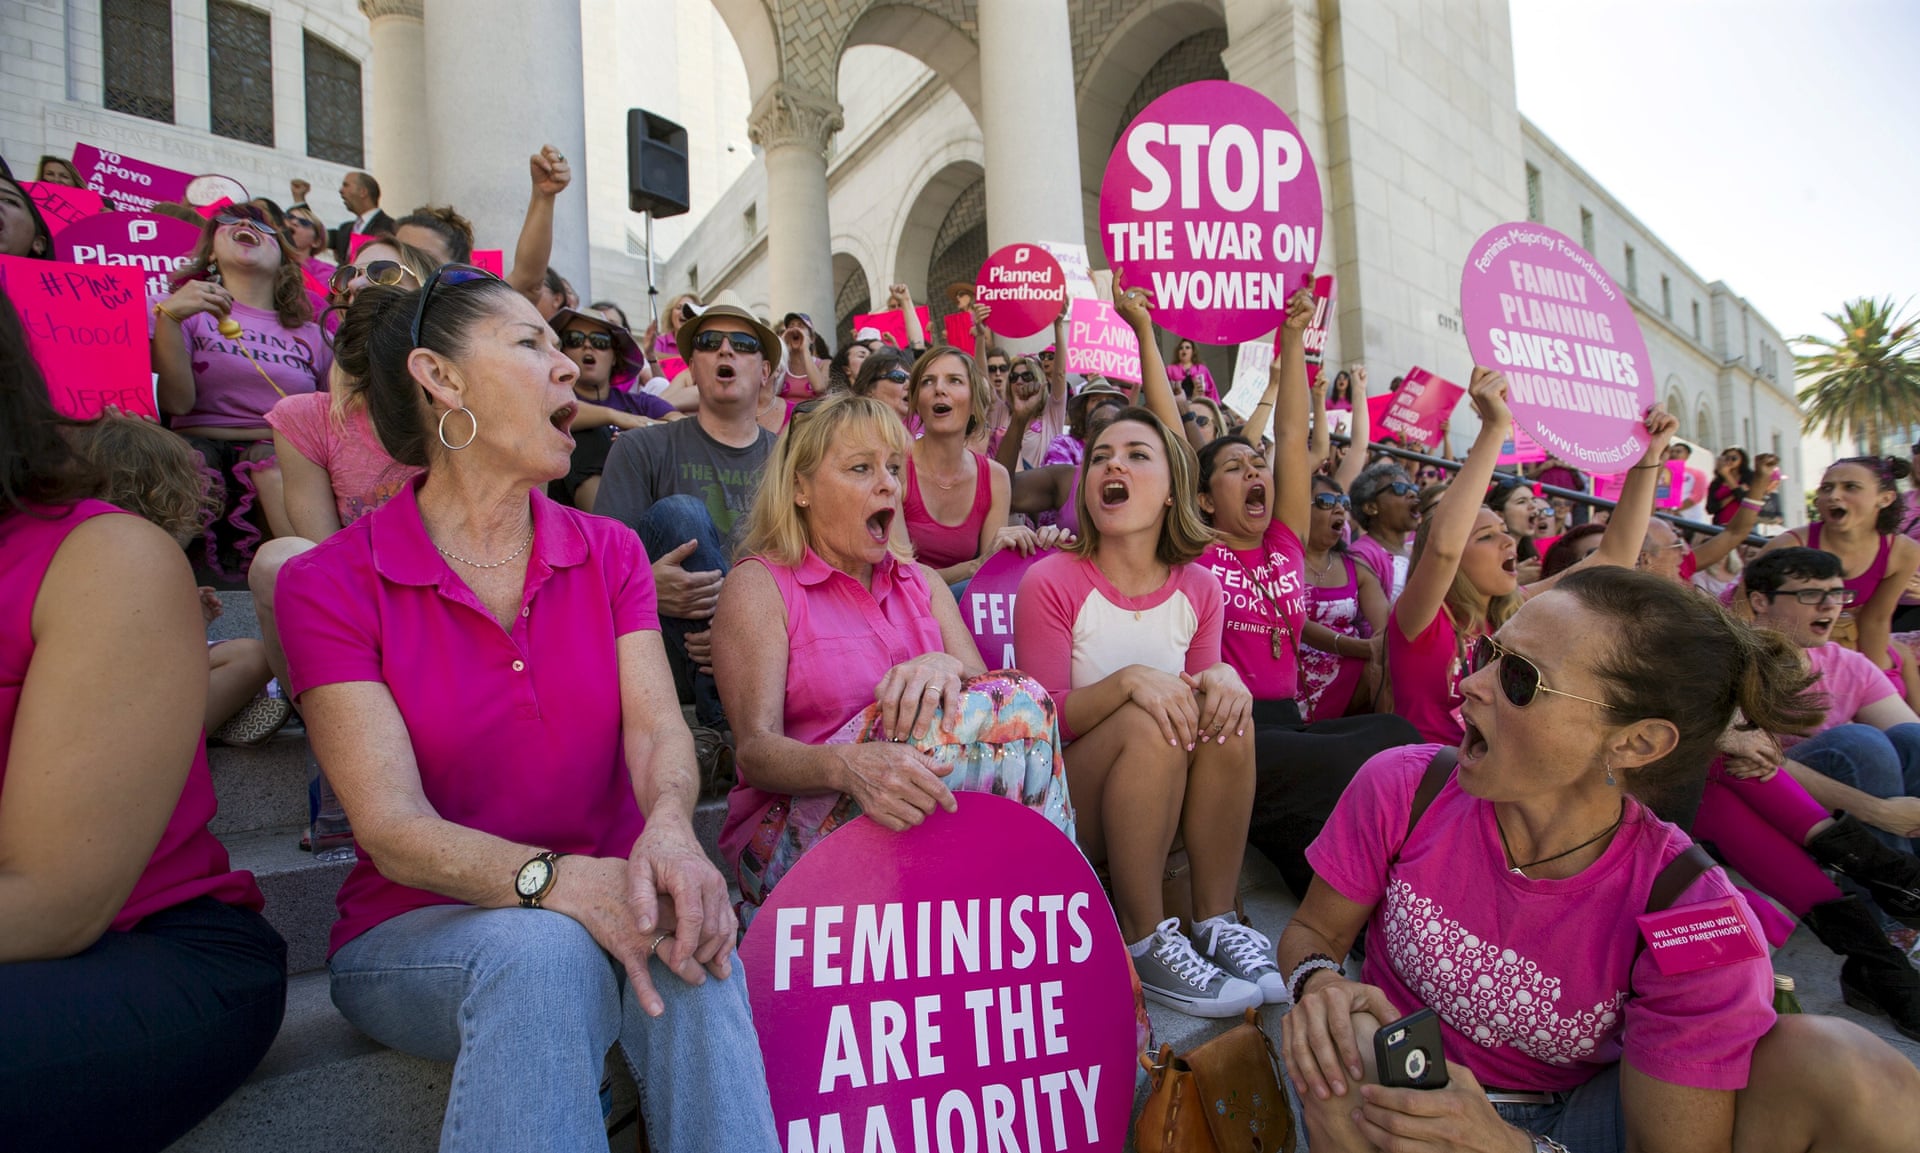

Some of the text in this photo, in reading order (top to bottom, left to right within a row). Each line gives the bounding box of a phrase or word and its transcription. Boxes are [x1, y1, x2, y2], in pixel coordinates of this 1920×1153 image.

[99, 149, 121, 165] YO
[1127, 122, 1303, 212] STOP
[90, 172, 104, 184] A
[93, 161, 152, 186] APOYO
[87, 181, 160, 209] PLANNE
[72, 244, 199, 272] Planne
[1108, 221, 1174, 262] THE
[1184, 221, 1263, 261] WAR
[1272, 223, 1315, 264] ON
[990, 266, 1052, 284] Planned
[1474, 229, 1616, 302] Feminist Majority Foundation
[976, 284, 1065, 301] Parenthood
[1151, 270, 1284, 310] WOMEN
[1509, 260, 1588, 305] FAMILY
[1096, 302, 1112, 322] I
[1499, 293, 1614, 344] PLANNING
[1073, 321, 1138, 352] PLANNE
[1067, 347, 1141, 378] PARENTHOO
[1489, 327, 1640, 387] SAVES LIVES
[1504, 370, 1643, 422] WORLDWIDE
[1536, 420, 1641, 465] www.feminist.org
[680, 463, 713, 481] THE
[774, 892, 1093, 991] FEMINISTS
[1652, 915, 1738, 939] WILL YOU STAND WITH
[1652, 937, 1689, 949] PLANNED
[819, 980, 1069, 1094] ARE THE
